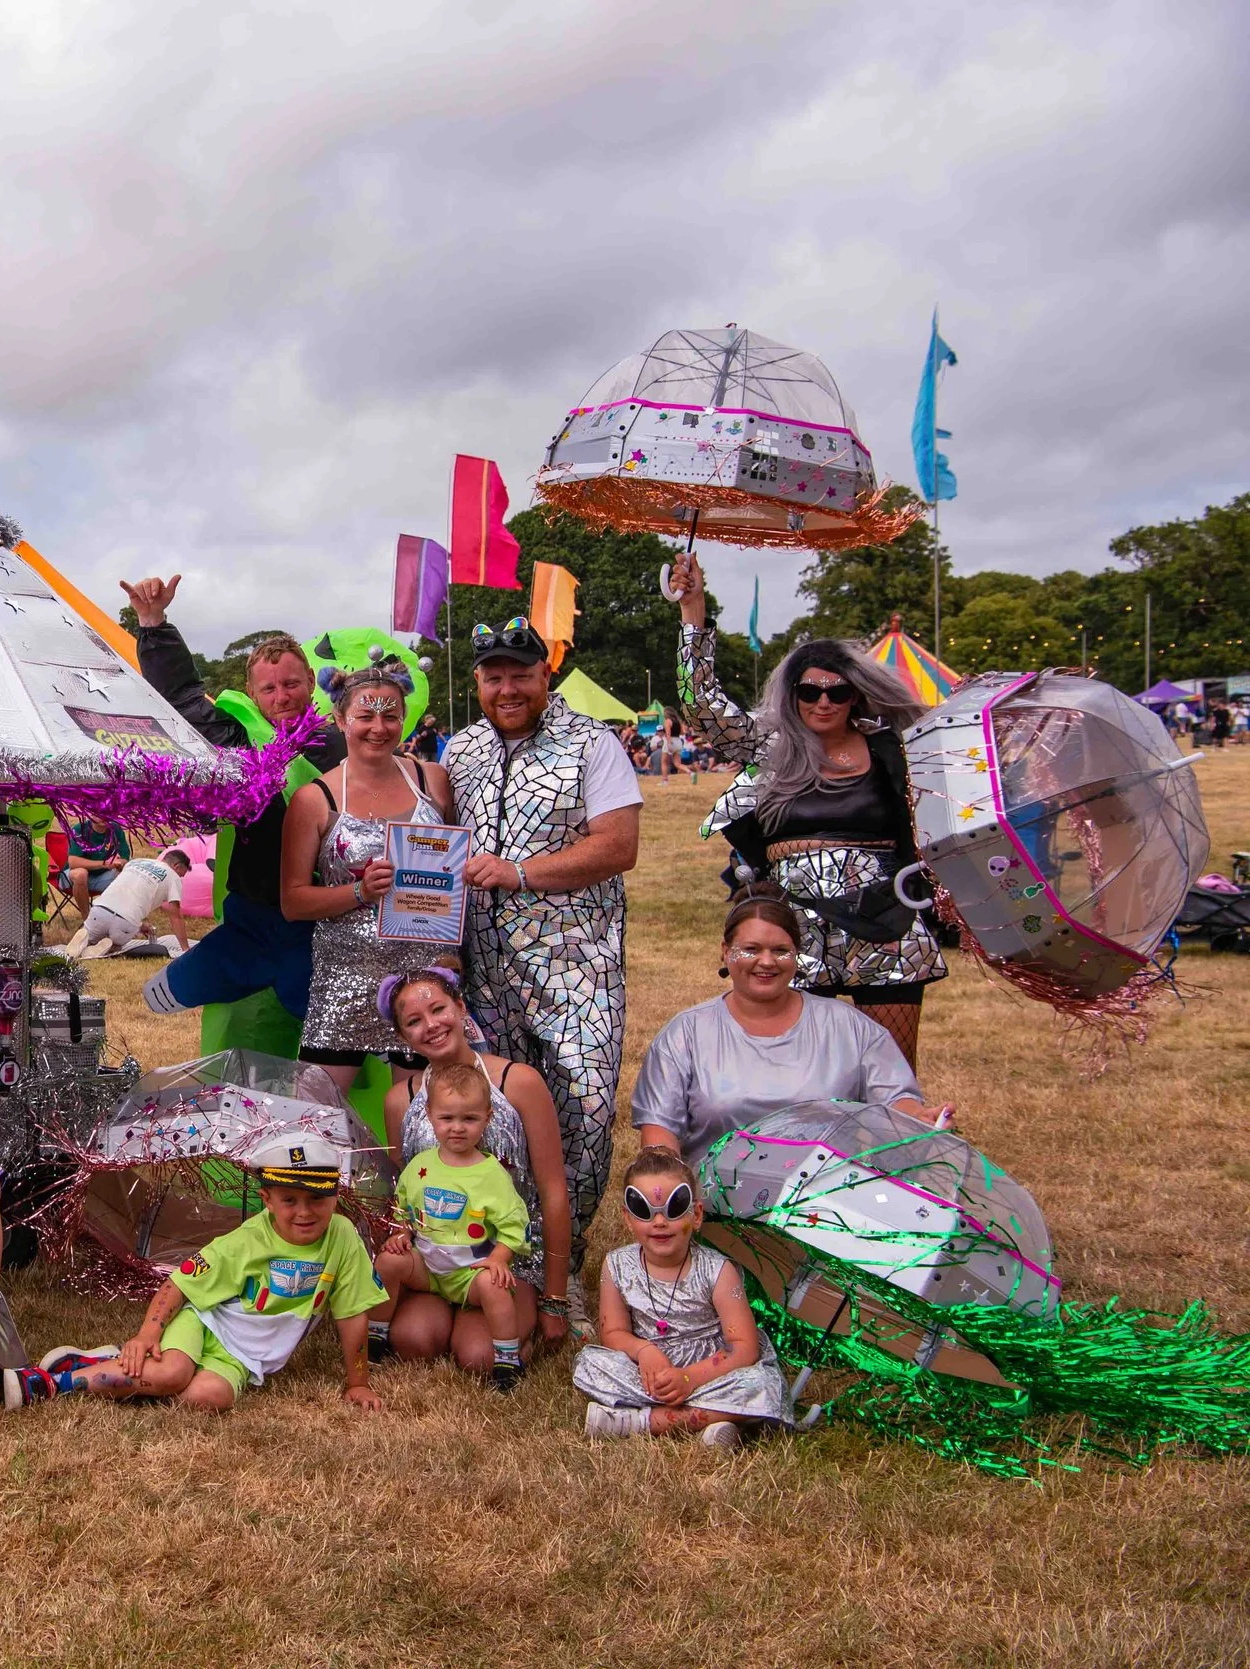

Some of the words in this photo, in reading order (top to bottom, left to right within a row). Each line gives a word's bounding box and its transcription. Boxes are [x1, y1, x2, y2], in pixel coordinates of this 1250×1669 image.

[95, 728, 174, 752] GUZZLER
[408, 835, 449, 846] Camper
[413, 842, 434, 852] Jam
[402, 873, 448, 886] Winner
[417, 900, 448, 908] Competition
[0, 990, 23, 1001] ourz
[270, 1260, 297, 1271] SPACE
